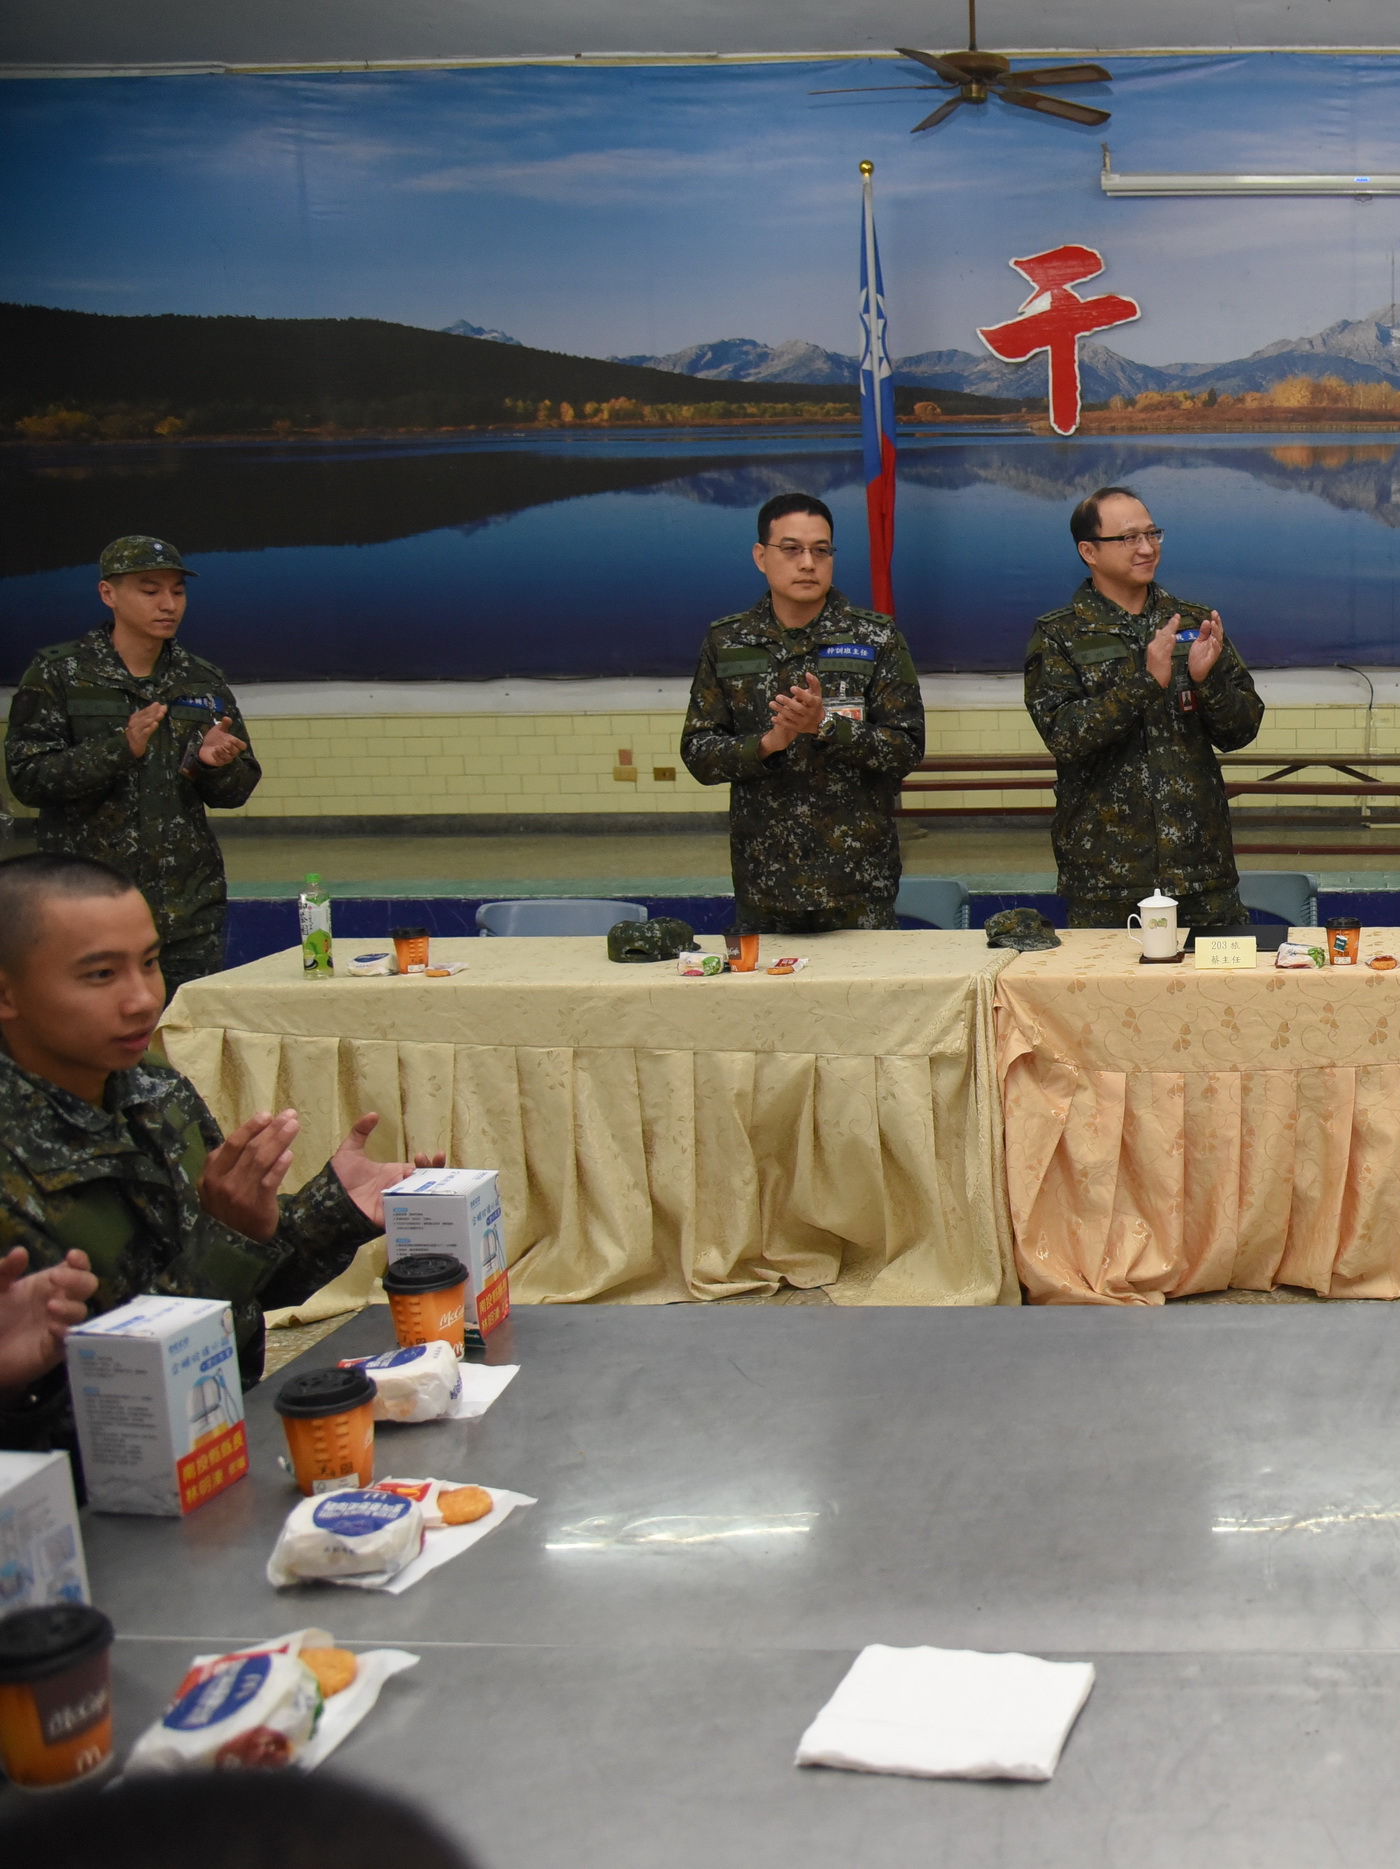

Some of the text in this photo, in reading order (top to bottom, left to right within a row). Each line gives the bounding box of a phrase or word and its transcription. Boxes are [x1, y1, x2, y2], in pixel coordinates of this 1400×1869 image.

[827, 647, 869, 657] 幹訓班主任
[1211, 941, 1228, 950] 203
[1211, 955, 1242, 965] 蔡主任
